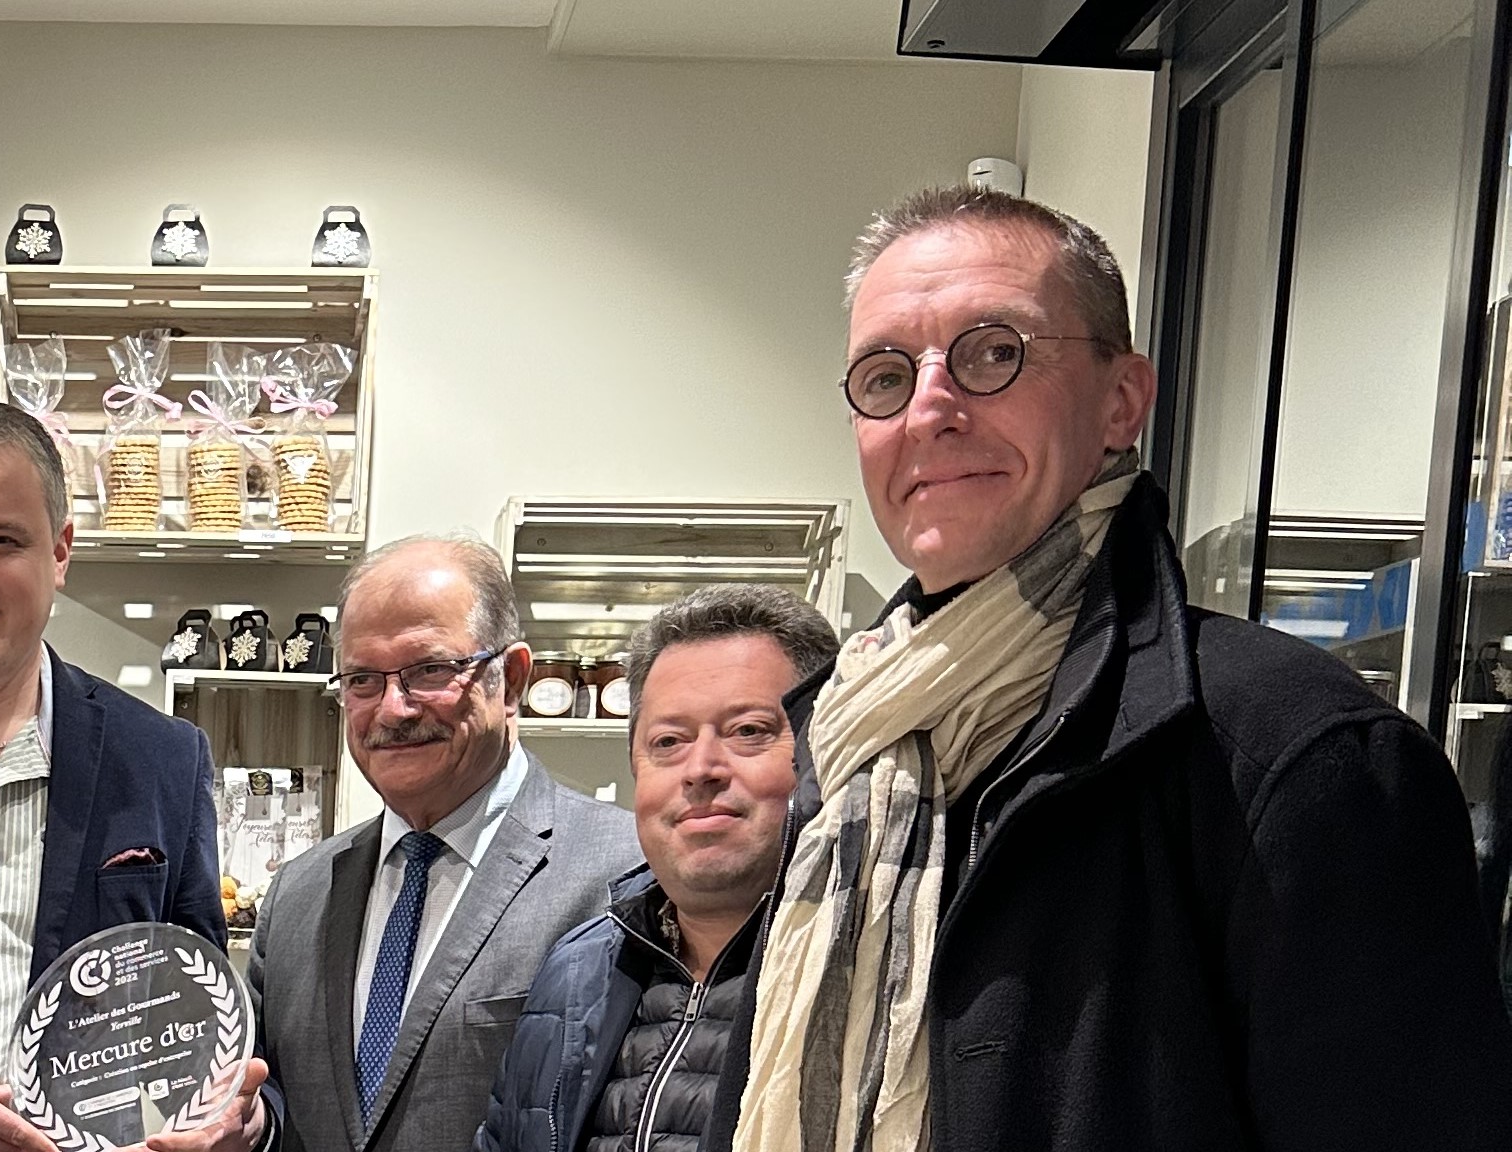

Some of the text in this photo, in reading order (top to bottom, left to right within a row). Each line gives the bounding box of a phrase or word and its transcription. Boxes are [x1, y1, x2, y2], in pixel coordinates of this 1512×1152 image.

[111, 939, 148, 954] Challenge
[114, 972, 139, 987] 2022
[68, 990, 181, 1030] L'Atelier des Gourmands
[110, 1015, 143, 1032] Yerville
[49, 1020, 207, 1079] Mercure d'or
